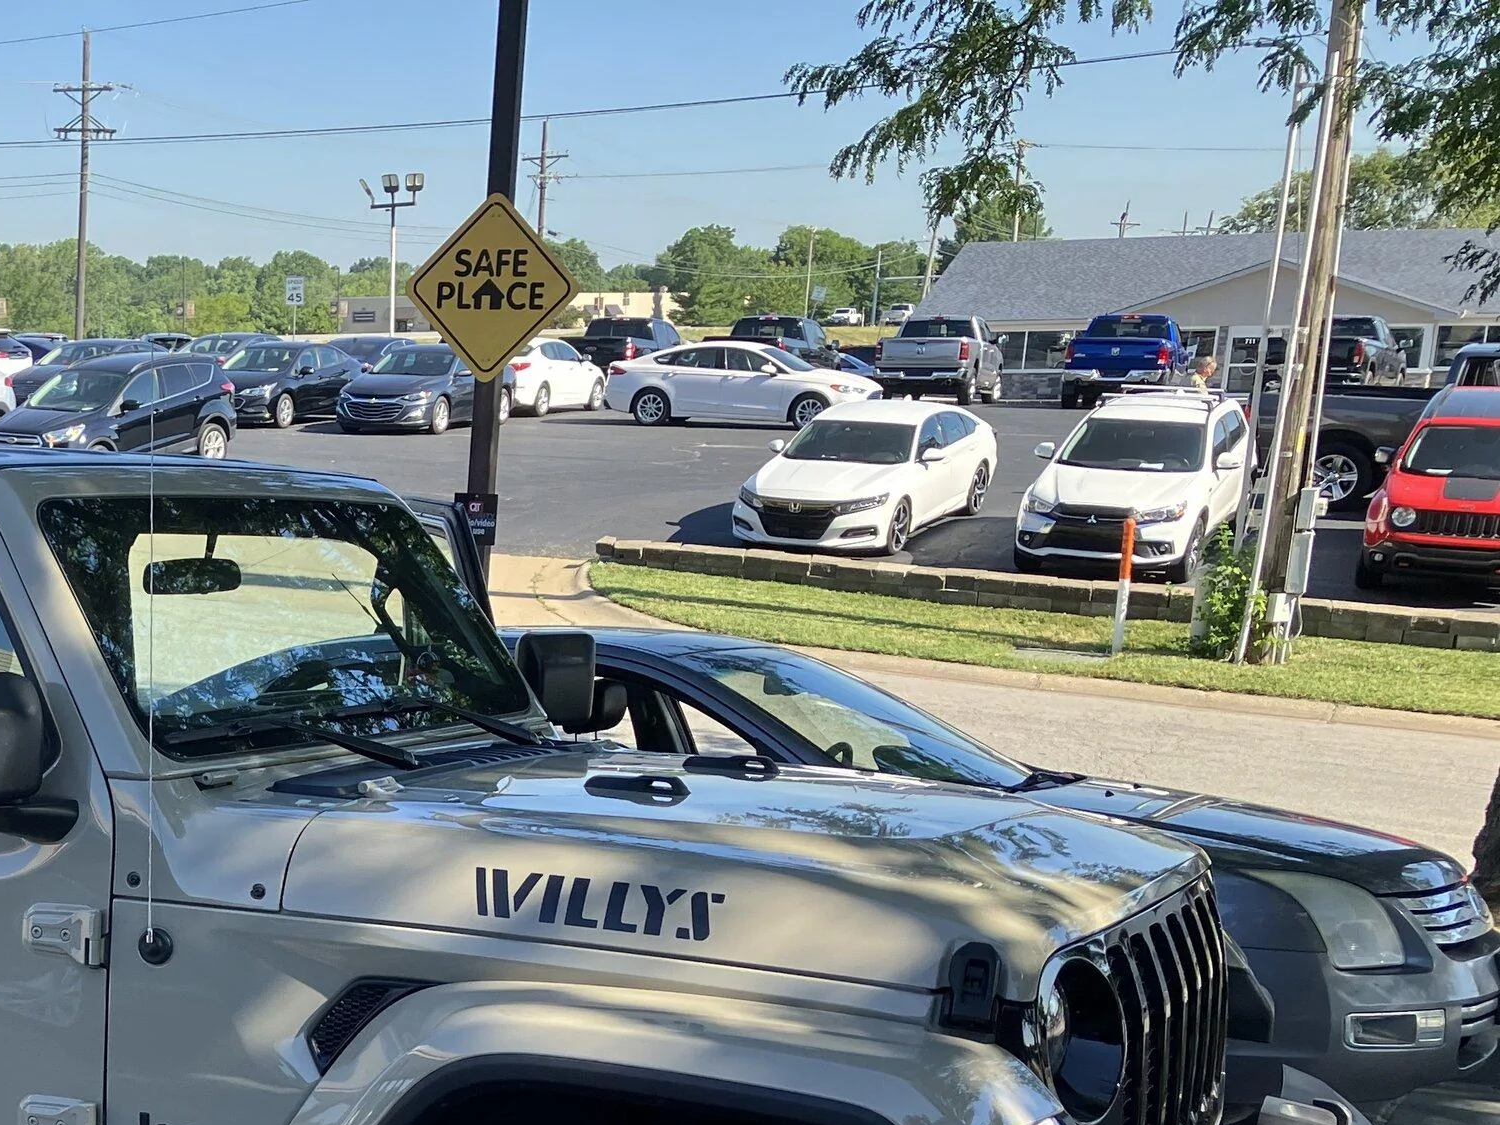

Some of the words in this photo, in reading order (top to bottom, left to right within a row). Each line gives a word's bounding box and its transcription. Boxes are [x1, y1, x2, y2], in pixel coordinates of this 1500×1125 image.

[454, 249, 529, 277] SAFE
[287, 292, 302, 303] 45
[470, 502, 481, 512] QT
[475, 866, 726, 941] WILLYS
